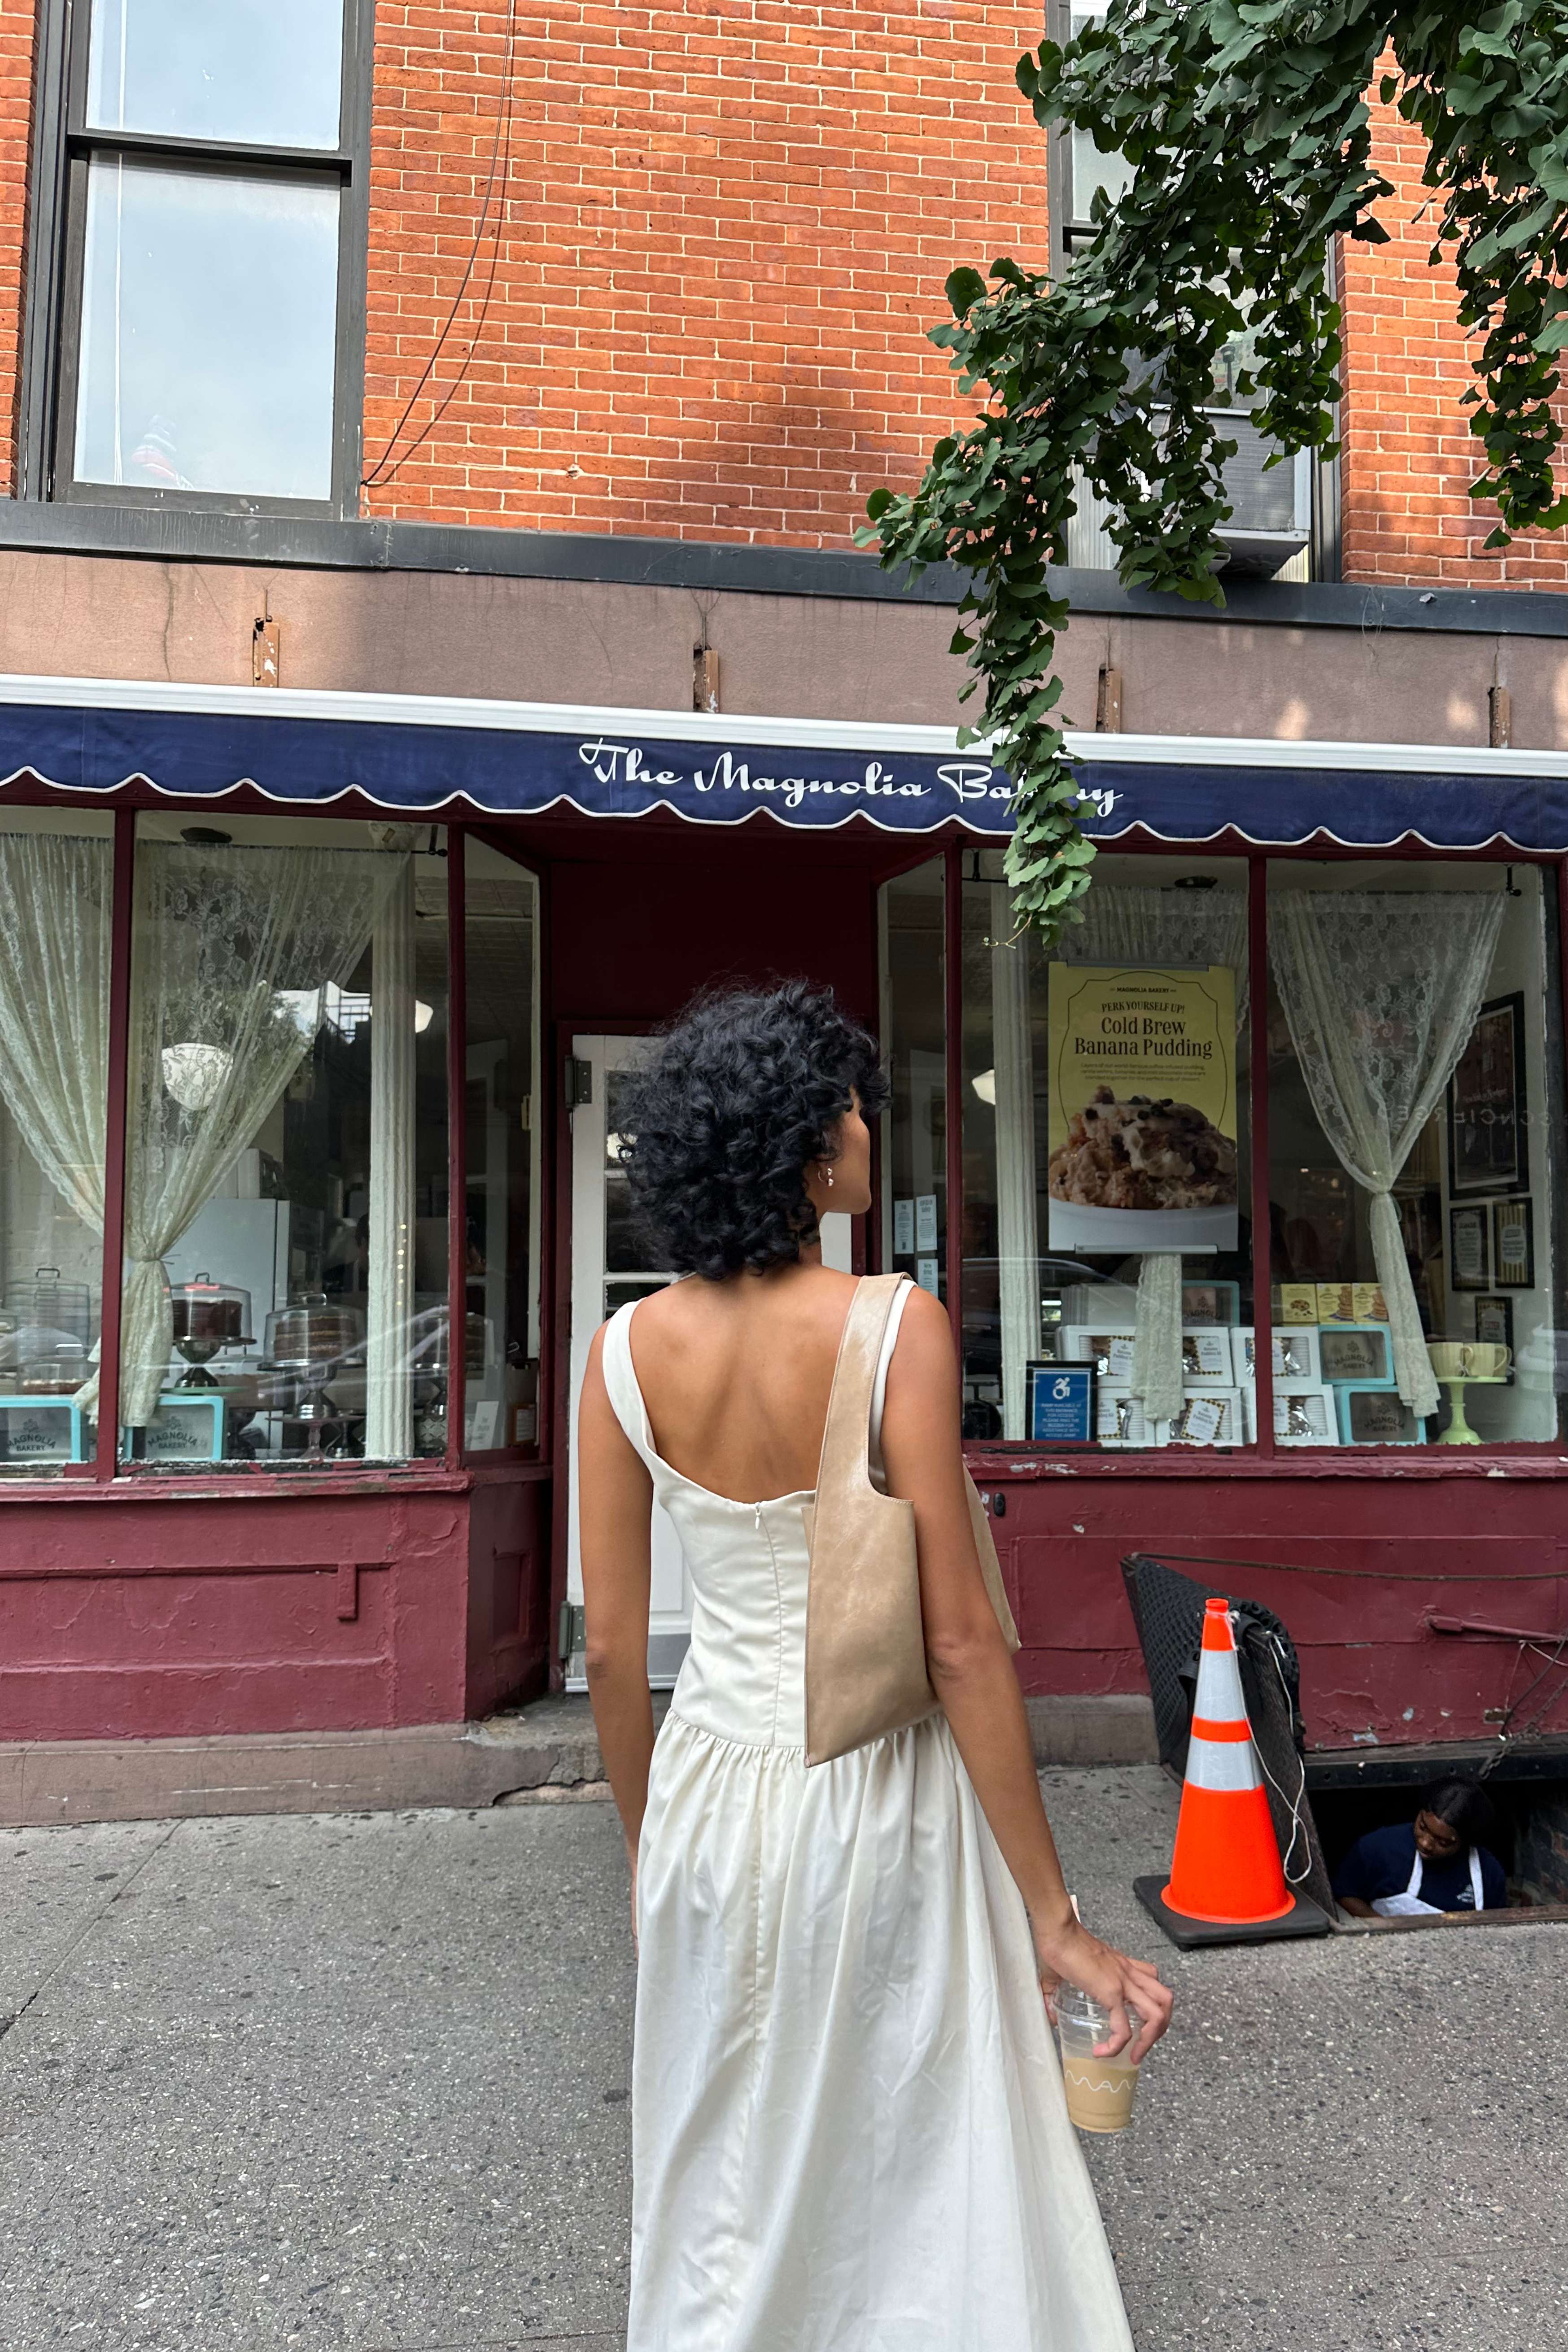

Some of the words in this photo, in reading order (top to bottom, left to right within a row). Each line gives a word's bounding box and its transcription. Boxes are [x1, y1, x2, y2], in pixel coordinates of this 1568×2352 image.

[579, 738, 683, 785] The
[694, 751, 931, 807] Magnolia
[937, 763, 1124, 818] Bary
[1101, 1001, 1125, 1013] PERK
[1126, 1001, 1170, 1011] YOURSELF
[1171, 1003, 1185, 1014] UP!
[1101, 1016, 1138, 1034] Cold
[1142, 1018, 1187, 1035] Brew
[1074, 1037, 1139, 1055] Banana
[1143, 1039, 1212, 1060] Pudding
[7, 1433, 56, 1449] MAGNOLIA
[148, 1431, 198, 1446] MAGNOLIA
